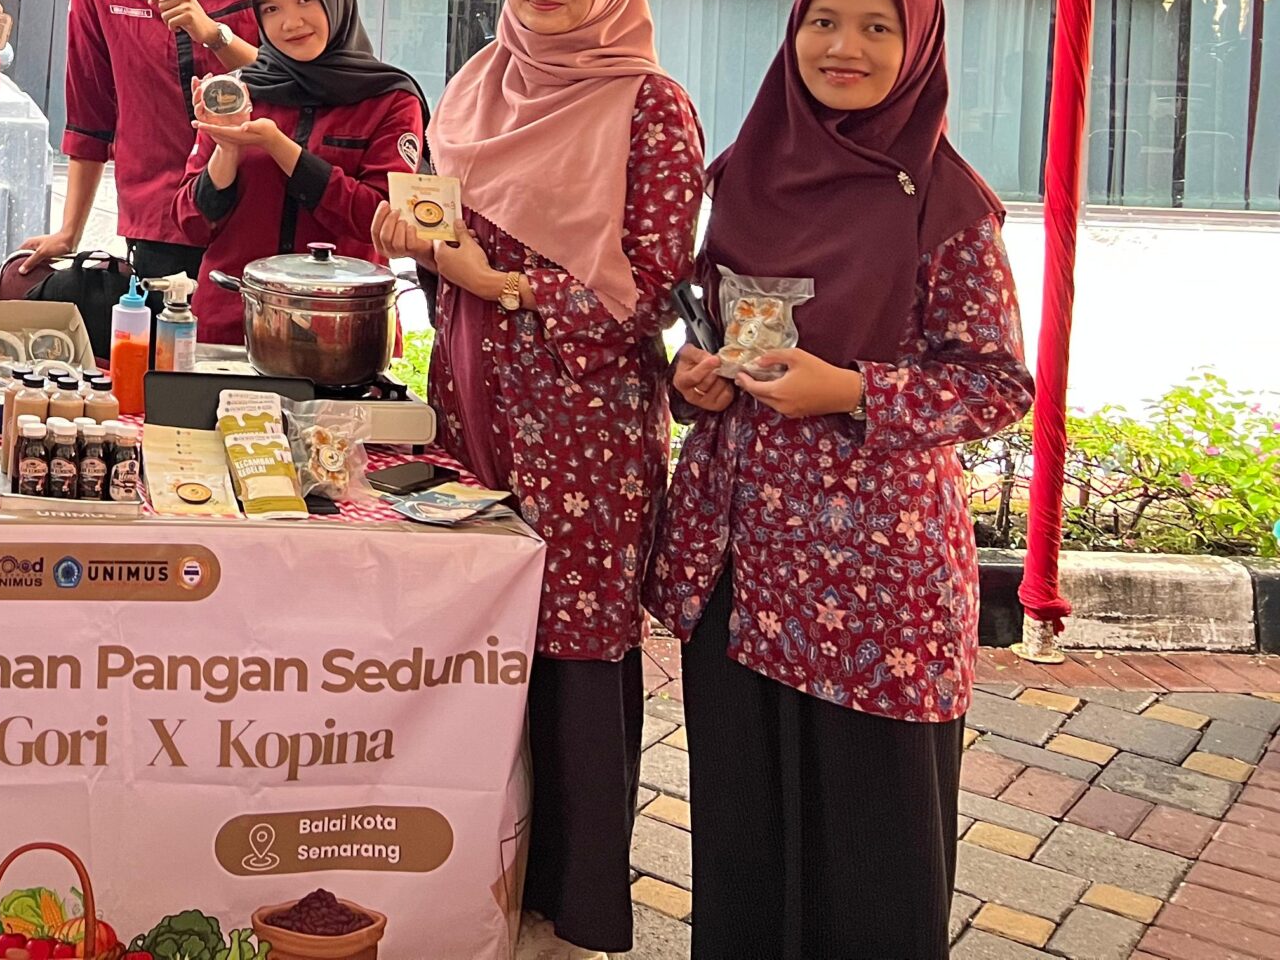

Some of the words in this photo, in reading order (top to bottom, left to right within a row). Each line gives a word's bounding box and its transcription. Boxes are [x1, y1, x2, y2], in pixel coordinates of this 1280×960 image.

[36, 510, 117, 519] UNIMUS
[87, 565, 169, 582] UNIMUS
[96, 645, 308, 703] Pangan
[321, 635, 528, 693] Sedunia
[147, 718, 189, 768] X
[216, 718, 395, 782] Kopina
[298, 814, 346, 835] Balai
[350, 814, 398, 831] Kota
[297, 843, 401, 864] Semarang
